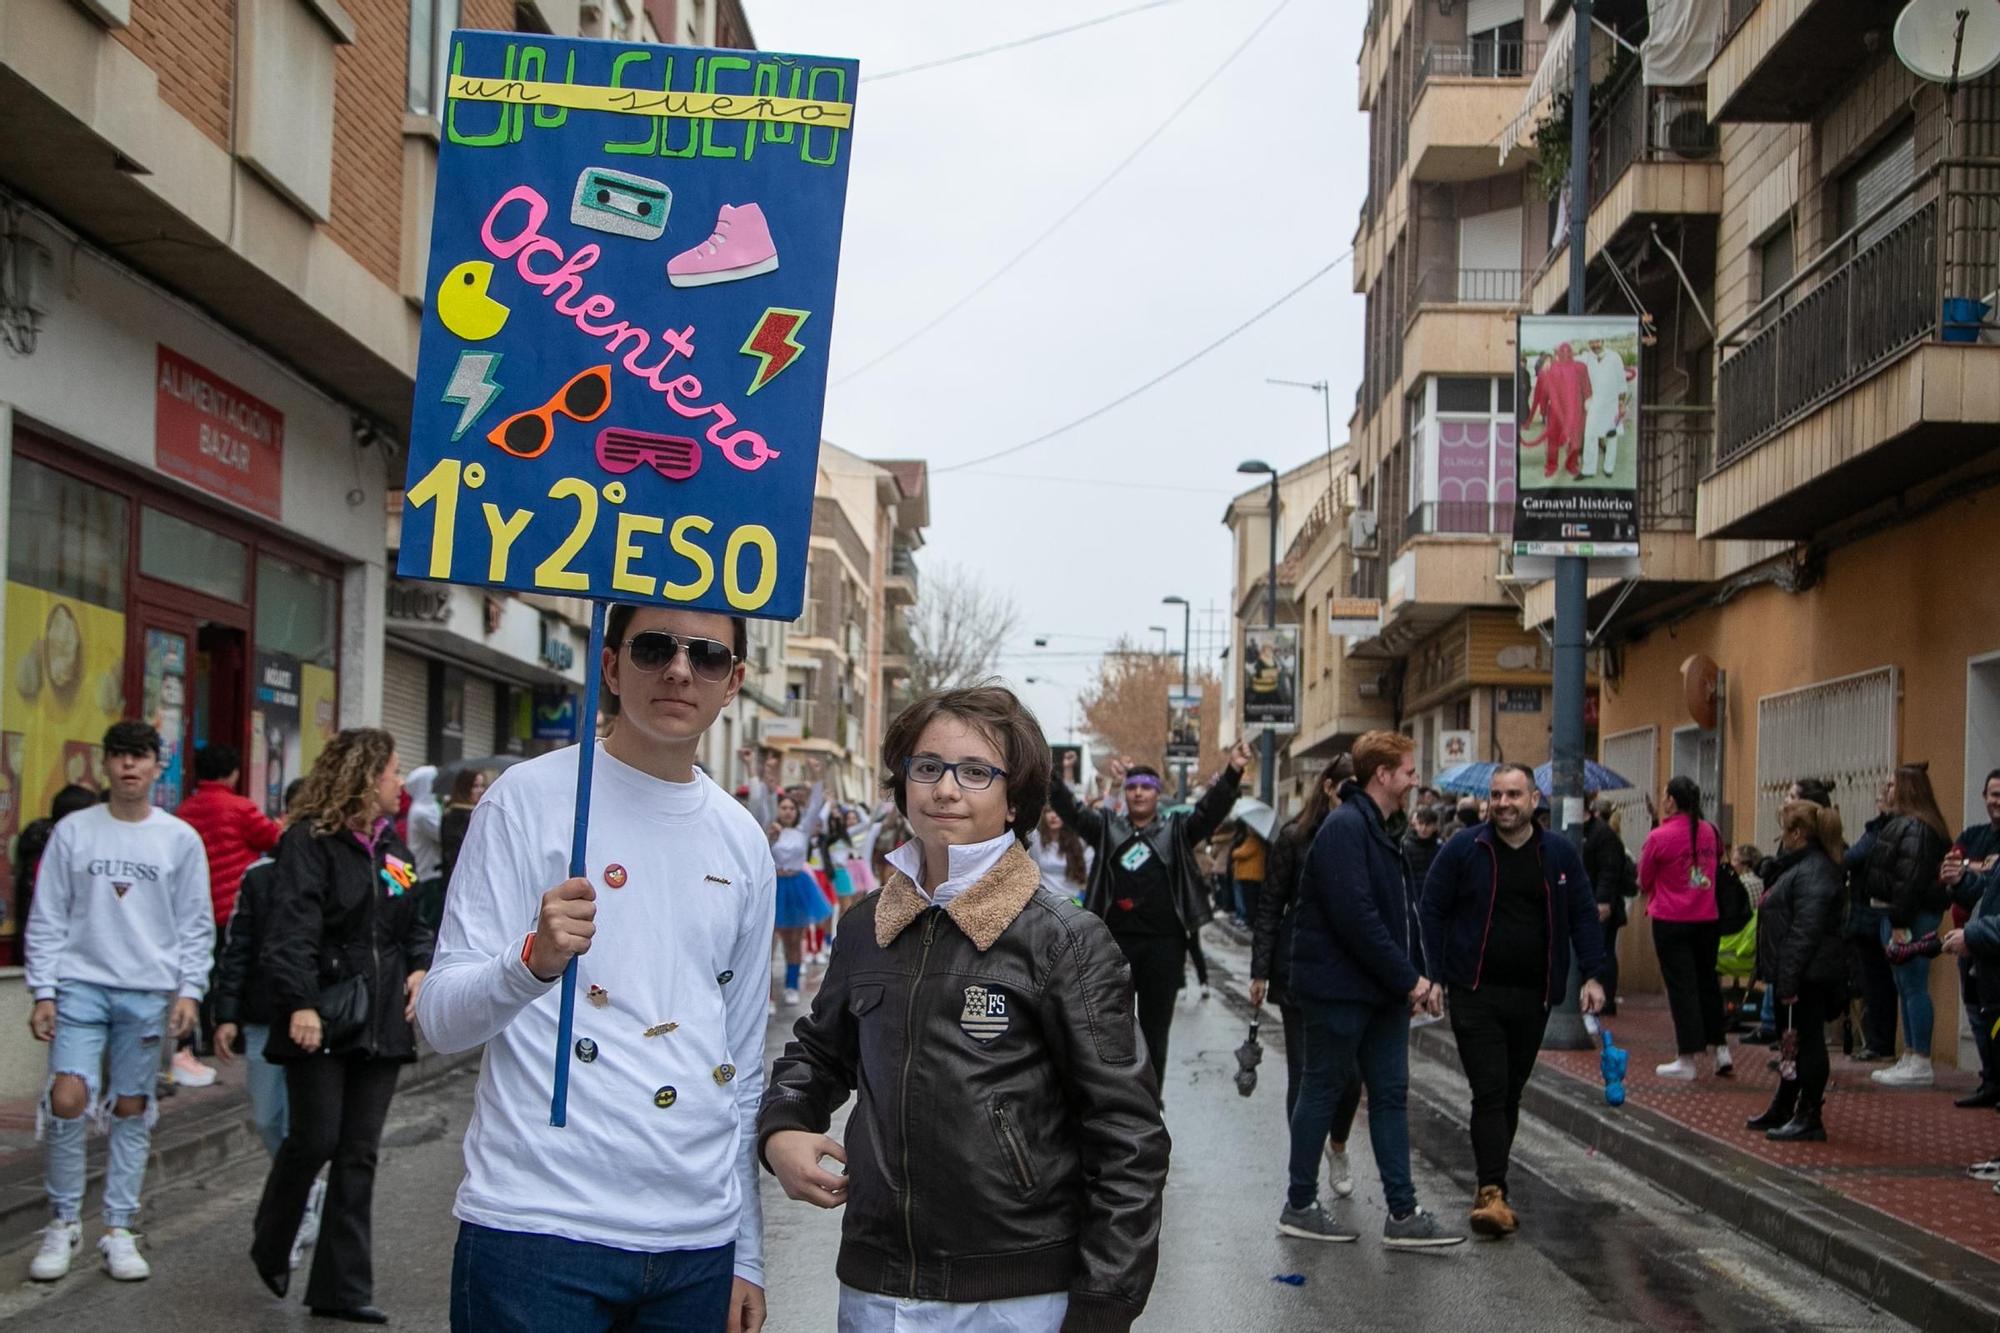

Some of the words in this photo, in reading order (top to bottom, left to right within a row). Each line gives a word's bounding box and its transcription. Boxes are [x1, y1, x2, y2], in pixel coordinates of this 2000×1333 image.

[458, 79, 541, 100] un
[608, 86, 847, 121] sueño
[604, 53, 846, 167] SUEÑO
[480, 185, 781, 471] Ochentero
[201, 423, 250, 473] BAZAR
[1522, 496, 1577, 510] Carnaval
[1579, 496, 1633, 511] histórico
[482, 502, 535, 583] Y
[612, 512, 778, 612] ESO
[87, 858, 161, 881] GUESS
[987, 994, 1005, 1014] FS
